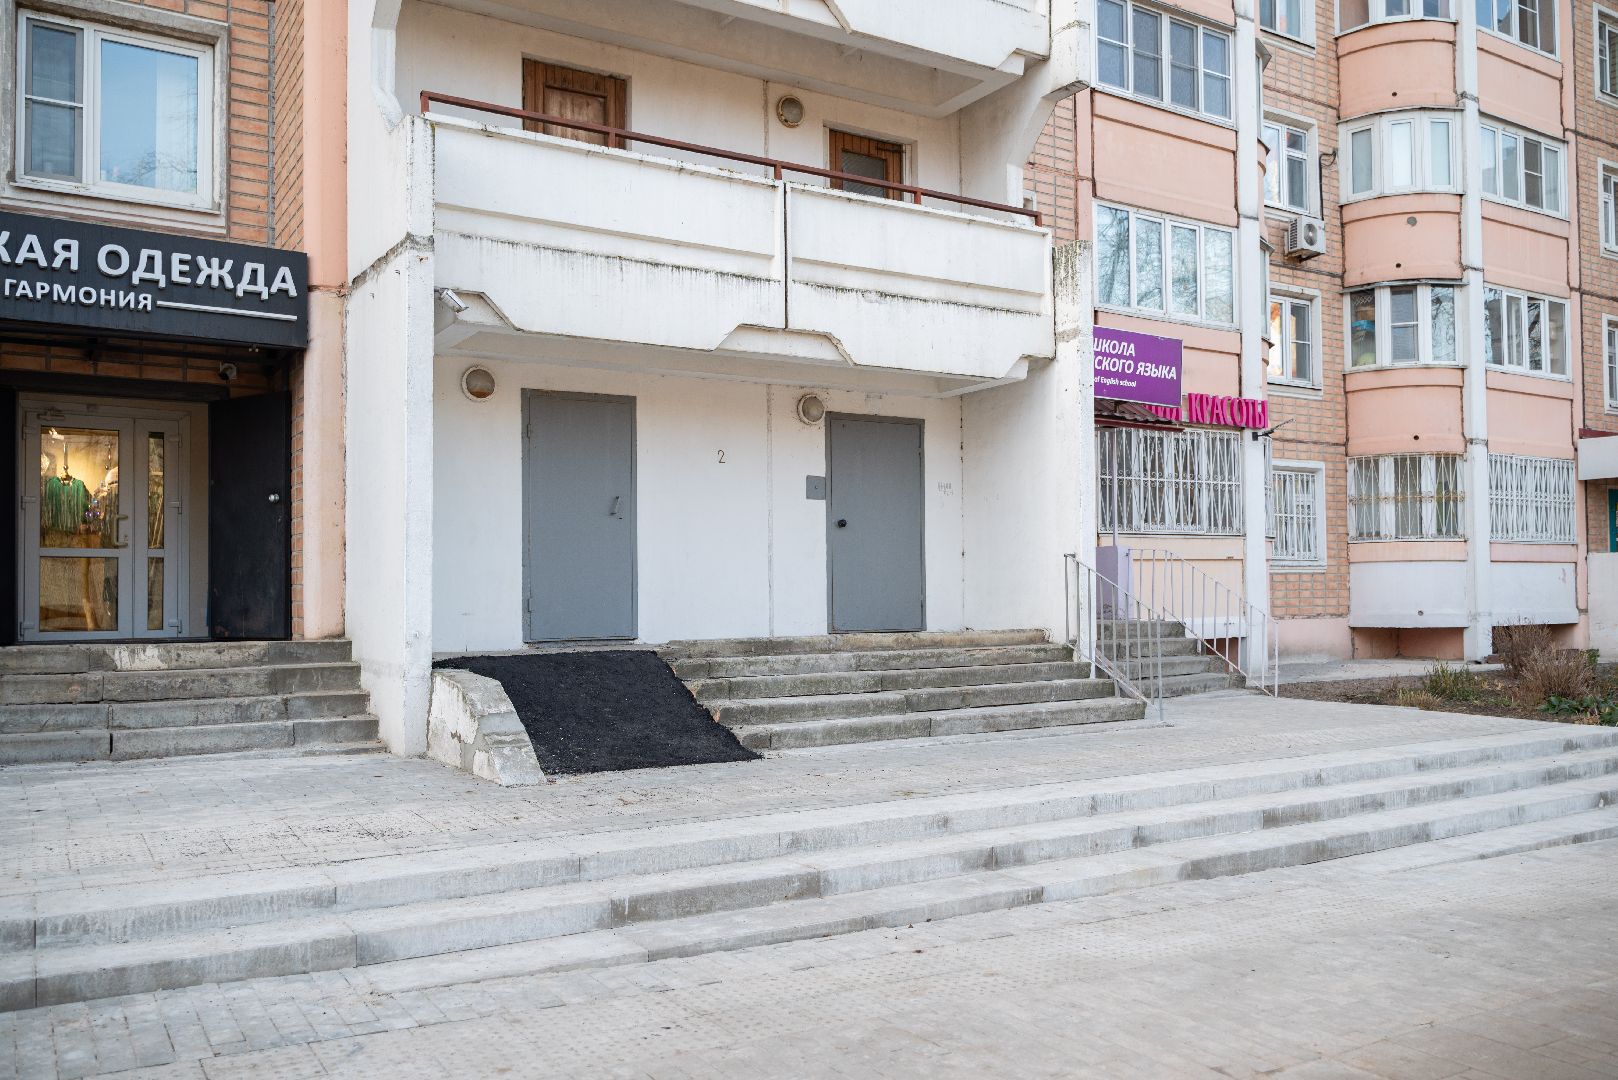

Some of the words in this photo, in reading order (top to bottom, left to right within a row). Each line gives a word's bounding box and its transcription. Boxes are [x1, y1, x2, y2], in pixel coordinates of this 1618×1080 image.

[97, 244, 297, 300] ОДЕЖДА
[4, 278, 152, 311] ГАРМОНИЯ
[1100, 376, 1119, 386] English
[1119, 380, 1137, 388] school
[1136, 361, 1177, 380] ЯЗЫКА
[1188, 393, 1268, 429] КРАСОТЫ
[717, 449, 726, 464] 2
